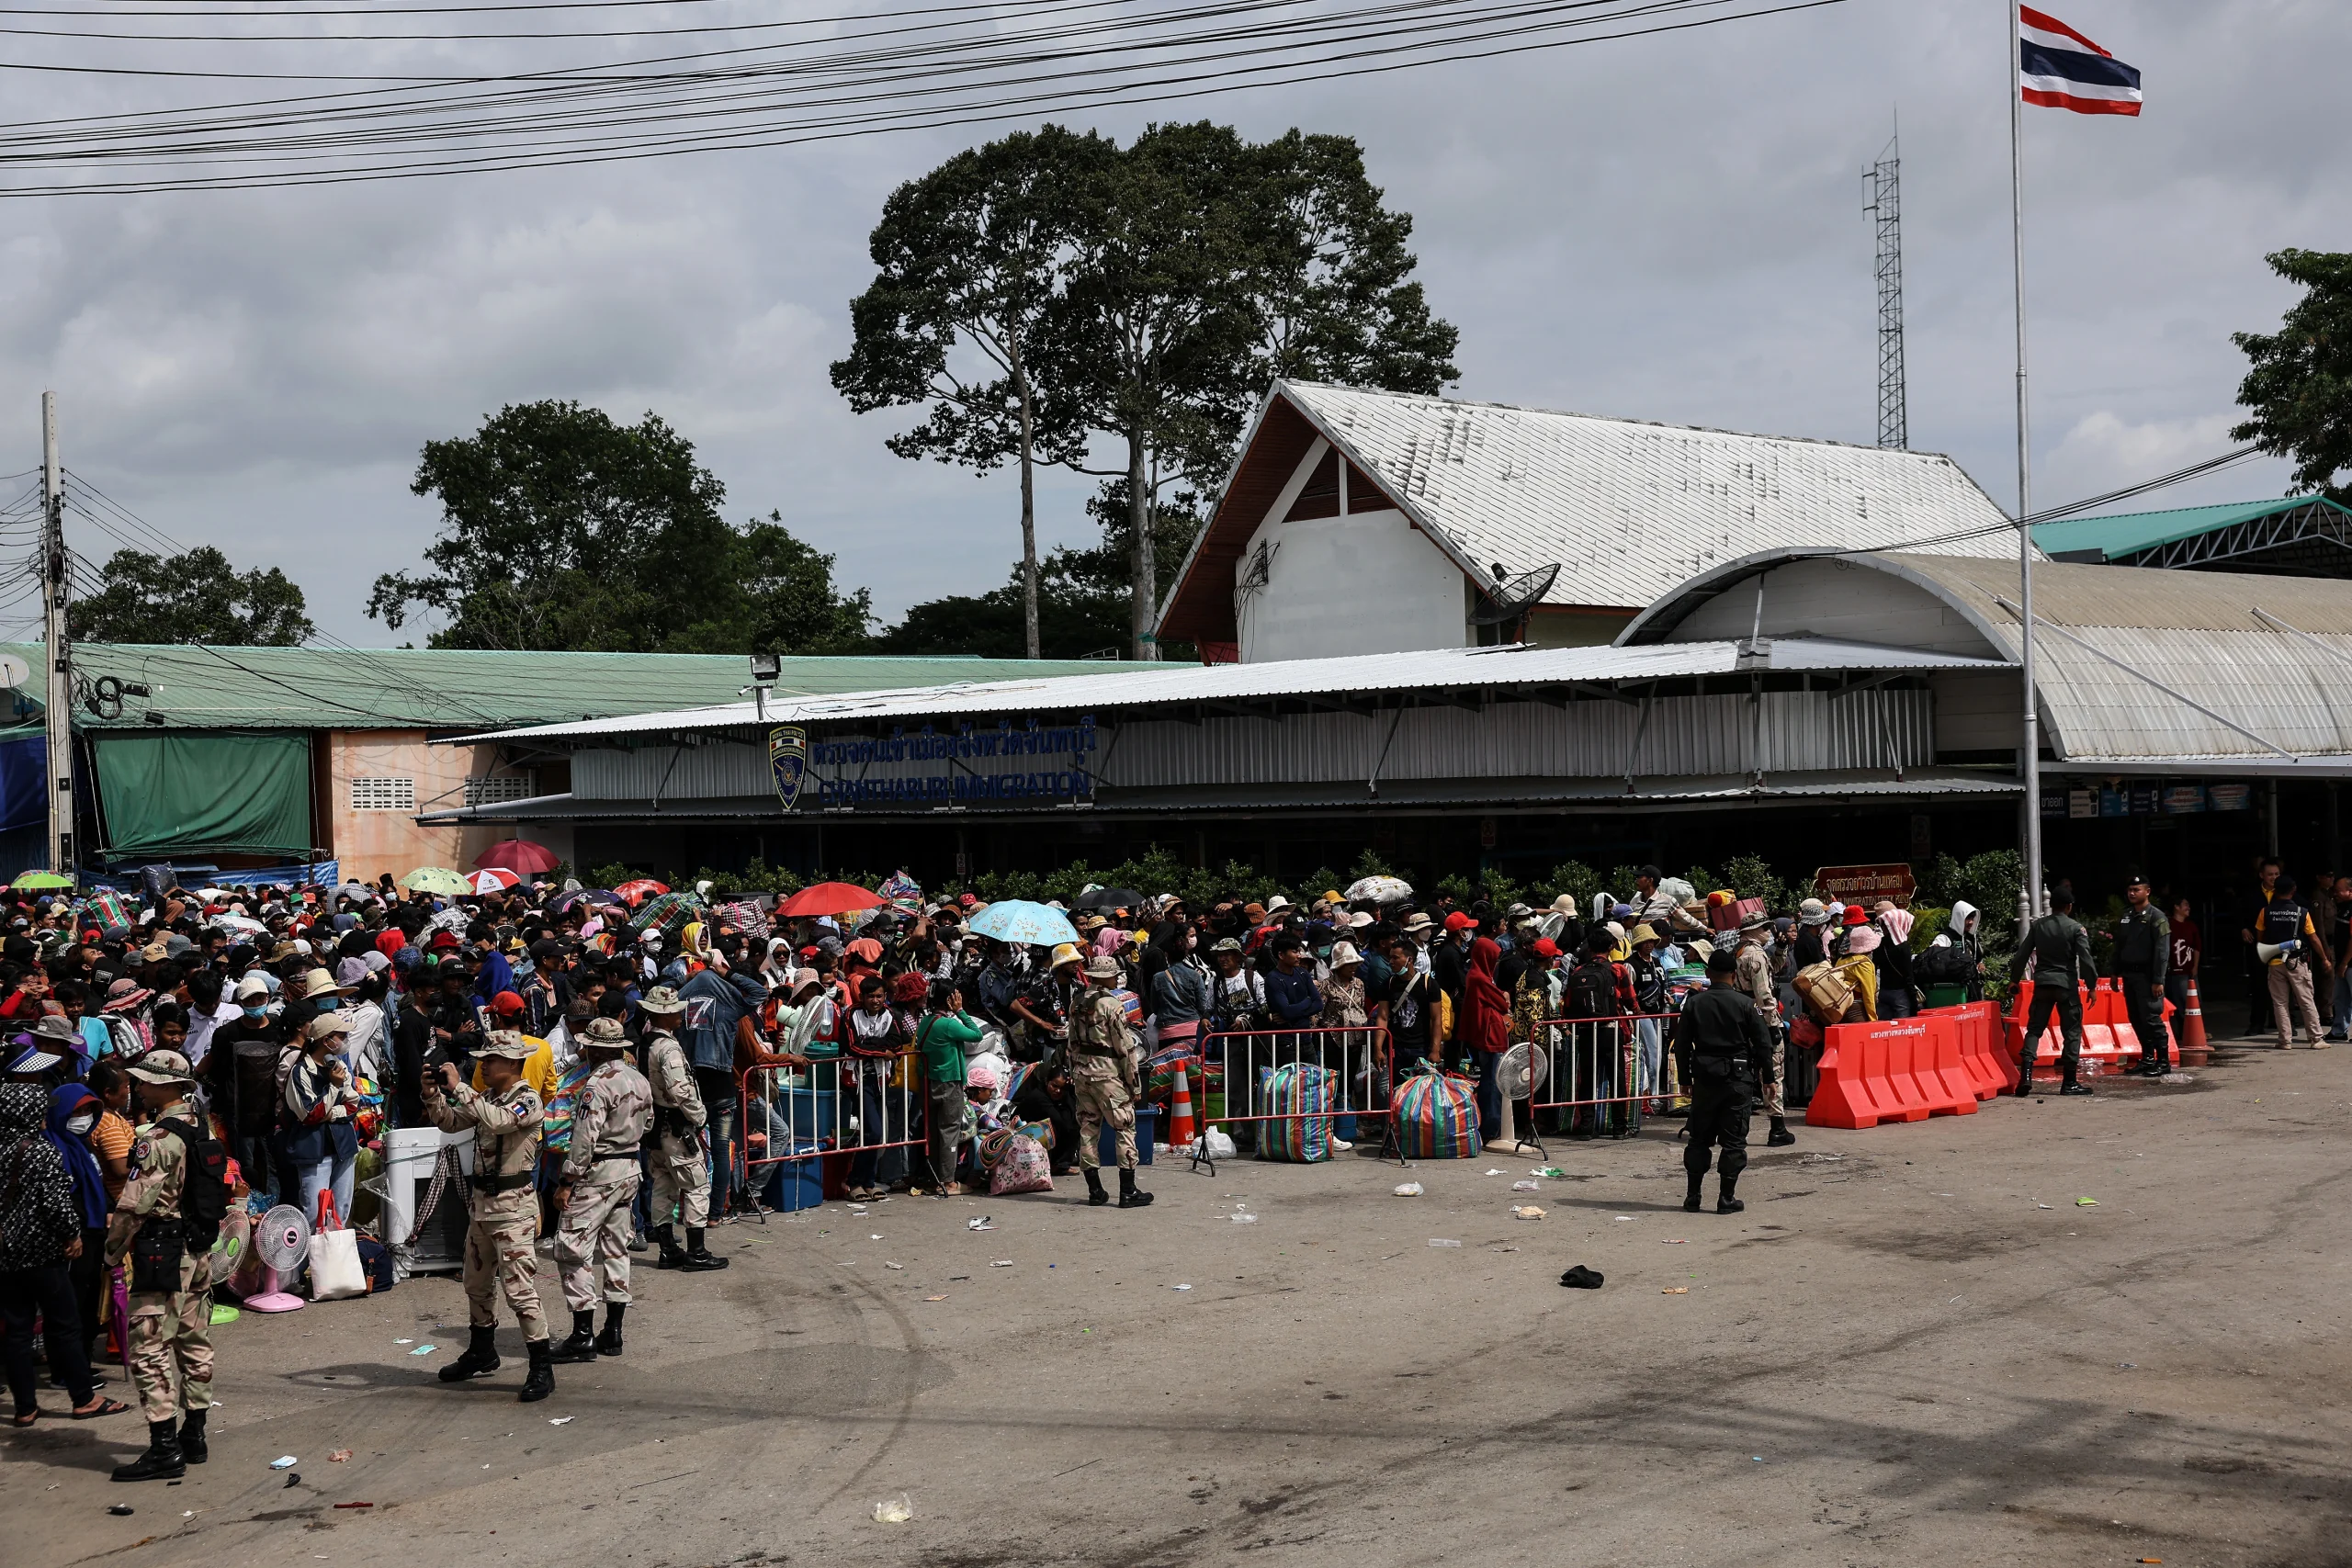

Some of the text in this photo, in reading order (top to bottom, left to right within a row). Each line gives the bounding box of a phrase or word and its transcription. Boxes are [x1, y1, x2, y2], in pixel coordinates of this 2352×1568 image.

[813, 715, 1097, 766] ตรวจคนเข้าเมืองจังหวัดจันทบุรี
[819, 776, 949, 804] CHANTHABURI
[954, 771, 1090, 800] IMMIGRATION
[2041, 796, 2064, 807] ขาออก
[1894, 894, 1910, 904] POINT
[1871, 1023, 1926, 1038] แขวงทางหลวงจันทบุรี
